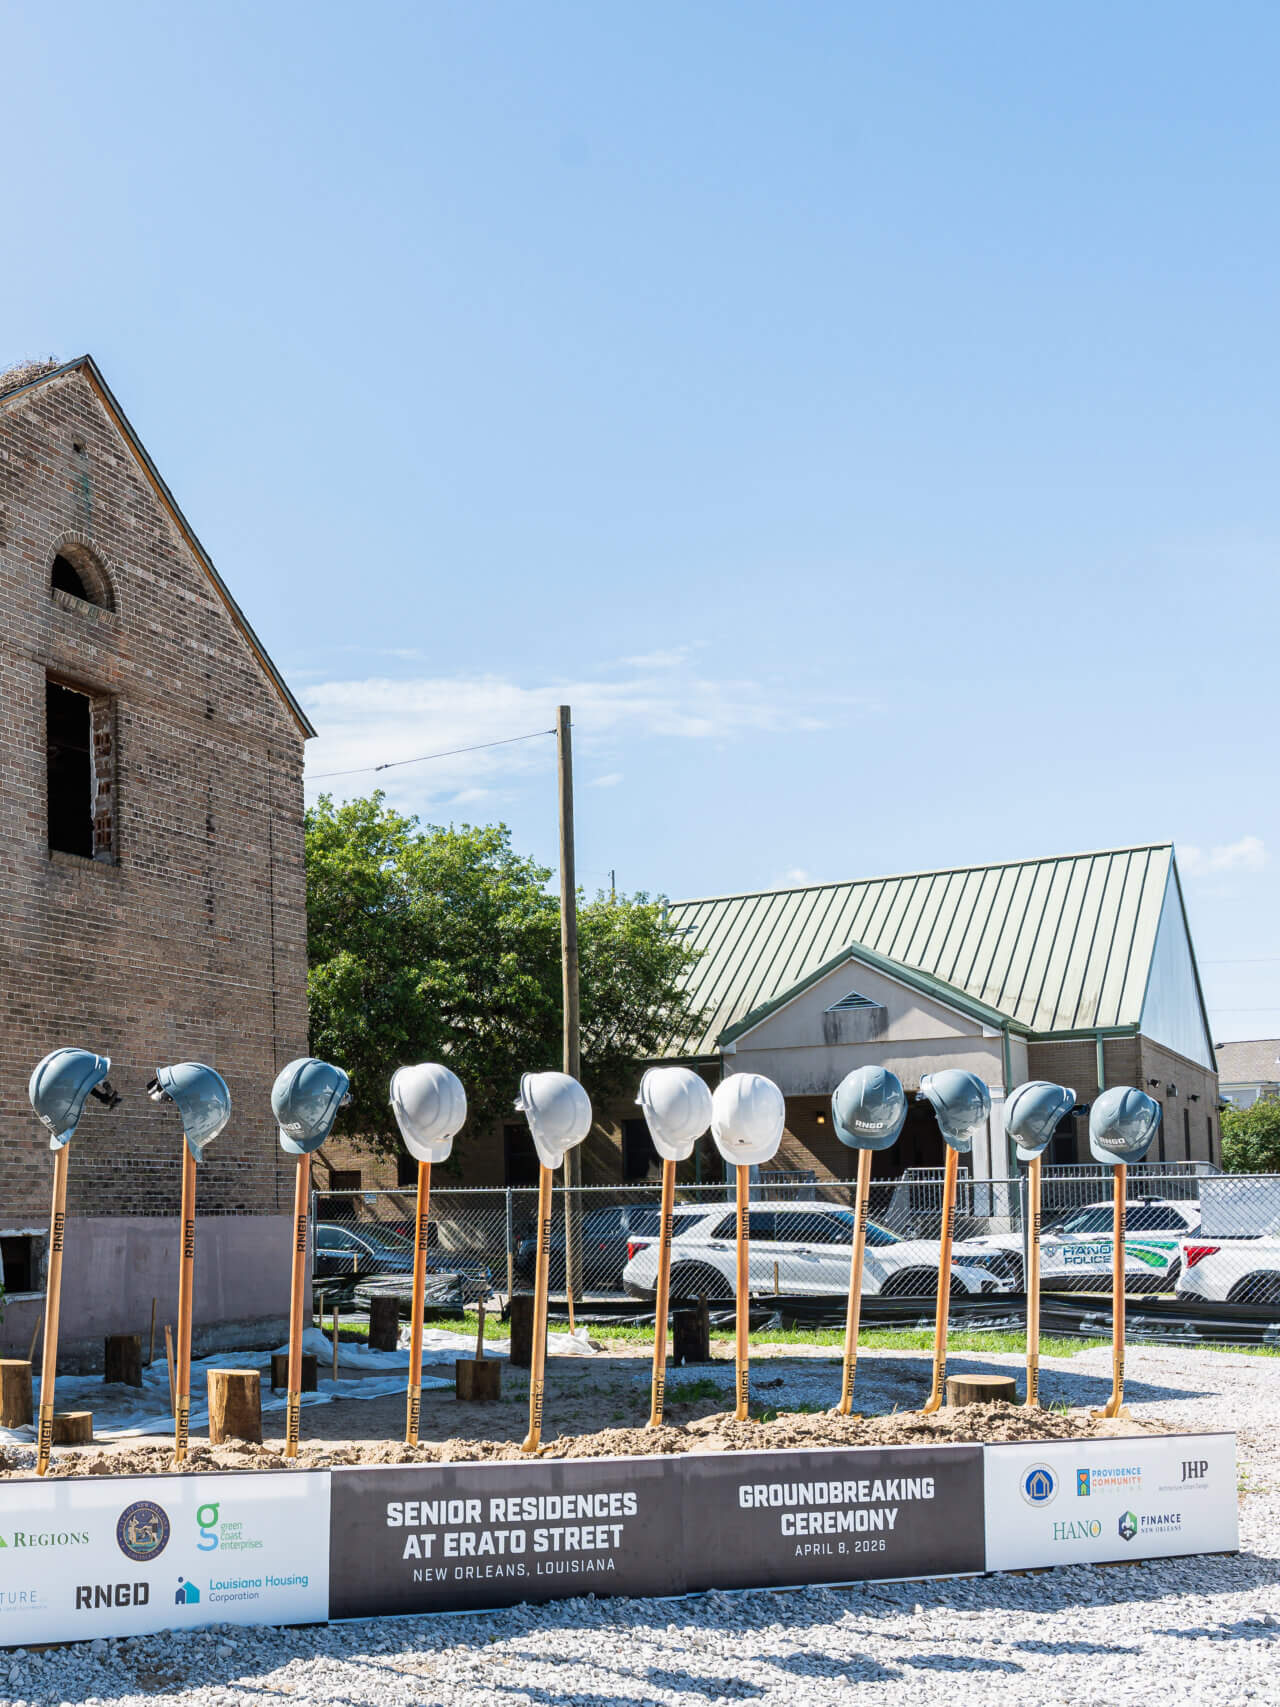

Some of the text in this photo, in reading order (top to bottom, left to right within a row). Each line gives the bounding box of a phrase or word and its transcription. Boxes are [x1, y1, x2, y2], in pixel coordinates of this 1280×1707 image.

[53, 1212, 65, 1252] RNGD
[185, 1220, 195, 1258] RNGD
[297, 1215, 307, 1252] RNGD
[1063, 1244, 1111, 1257] HANO
[1064, 1255, 1112, 1265] POLICE
[41, 1420, 52, 1460] RNGD
[1092, 1467, 1142, 1477] PROVIDENCE
[1181, 1460, 1209, 1482] JHP
[739, 1477, 935, 1508] GROUNDBREAKING
[1092, 1477, 1142, 1488] COMMUNITY
[387, 1492, 637, 1527] SENIOR RESIDENCES
[1140, 1513, 1181, 1526] FINANCE
[220, 1521, 243, 1531] green
[781, 1508, 898, 1536] CEREMONY
[1053, 1519, 1102, 1541] HANO
[13, 1532, 90, 1548] REGIONS
[220, 1540, 263, 1551] enterprises
[402, 1524, 624, 1560] AT ERATO STREET
[795, 1539, 886, 1557] APRIL 8, 2026
[413, 1558, 616, 1582] NEW ORLEANS, LOUISIANA
[209, 1574, 309, 1590] Louisiana Housing
[75, 1582, 150, 1610] RNGD
[209, 1591, 260, 1603] Corporation
